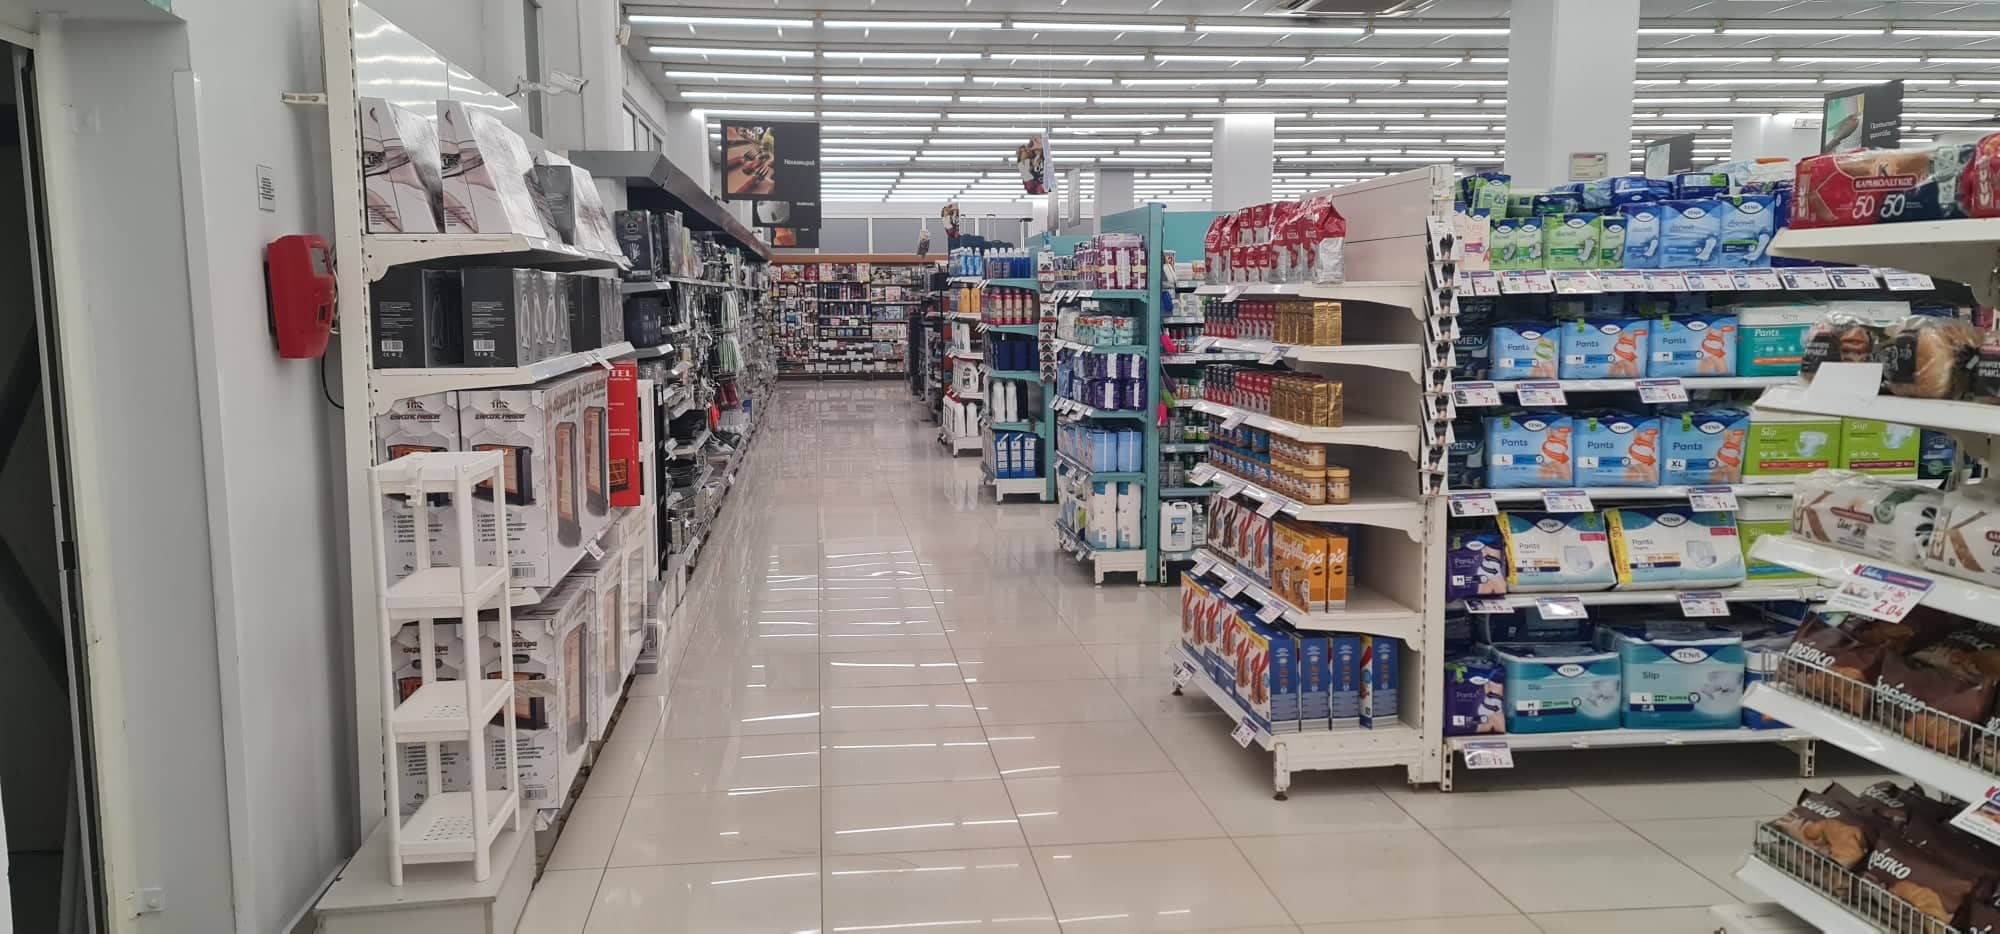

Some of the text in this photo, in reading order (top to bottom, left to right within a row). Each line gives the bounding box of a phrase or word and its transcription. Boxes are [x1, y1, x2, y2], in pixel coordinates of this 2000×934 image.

[1852, 194, 1905, 219] 50 50
[1754, 328, 1780, 338] Pants
[1576, 340, 1600, 348] Pants
[1662, 337, 1686, 345] Pants
[1501, 438, 1528, 447] Pants
[1587, 441, 1614, 449] Pants
[1673, 441, 1703, 450] Pants
[1671, 460, 1683, 468] XL
[1519, 542, 1541, 550] Pants
[1872, 600, 1904, 617] 2.04
[1677, 651, 1701, 659] TENA
[1642, 671, 1660, 681] Slip
